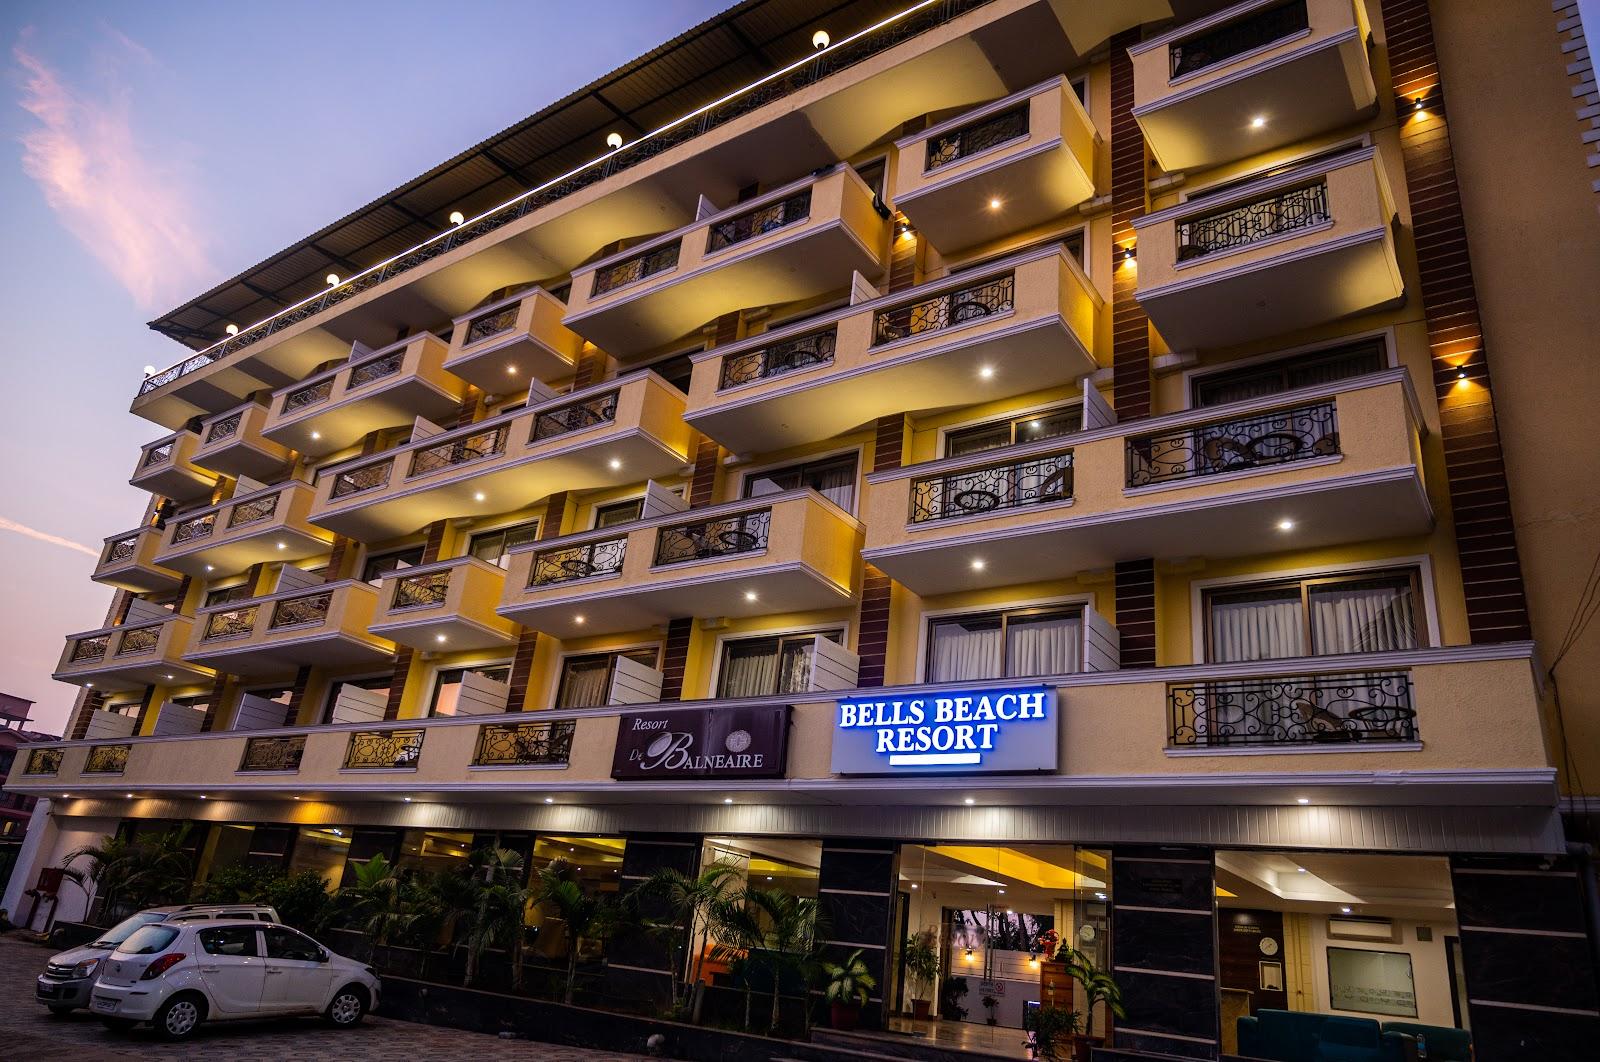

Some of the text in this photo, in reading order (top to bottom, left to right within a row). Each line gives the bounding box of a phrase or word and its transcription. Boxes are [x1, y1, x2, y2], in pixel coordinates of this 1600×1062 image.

[632, 719, 669, 731] Resort
[840, 693, 1046, 727] BELLS BEACH
[629, 732, 763, 770] De BALNEAIRE
[876, 725, 998, 753] RESORT
